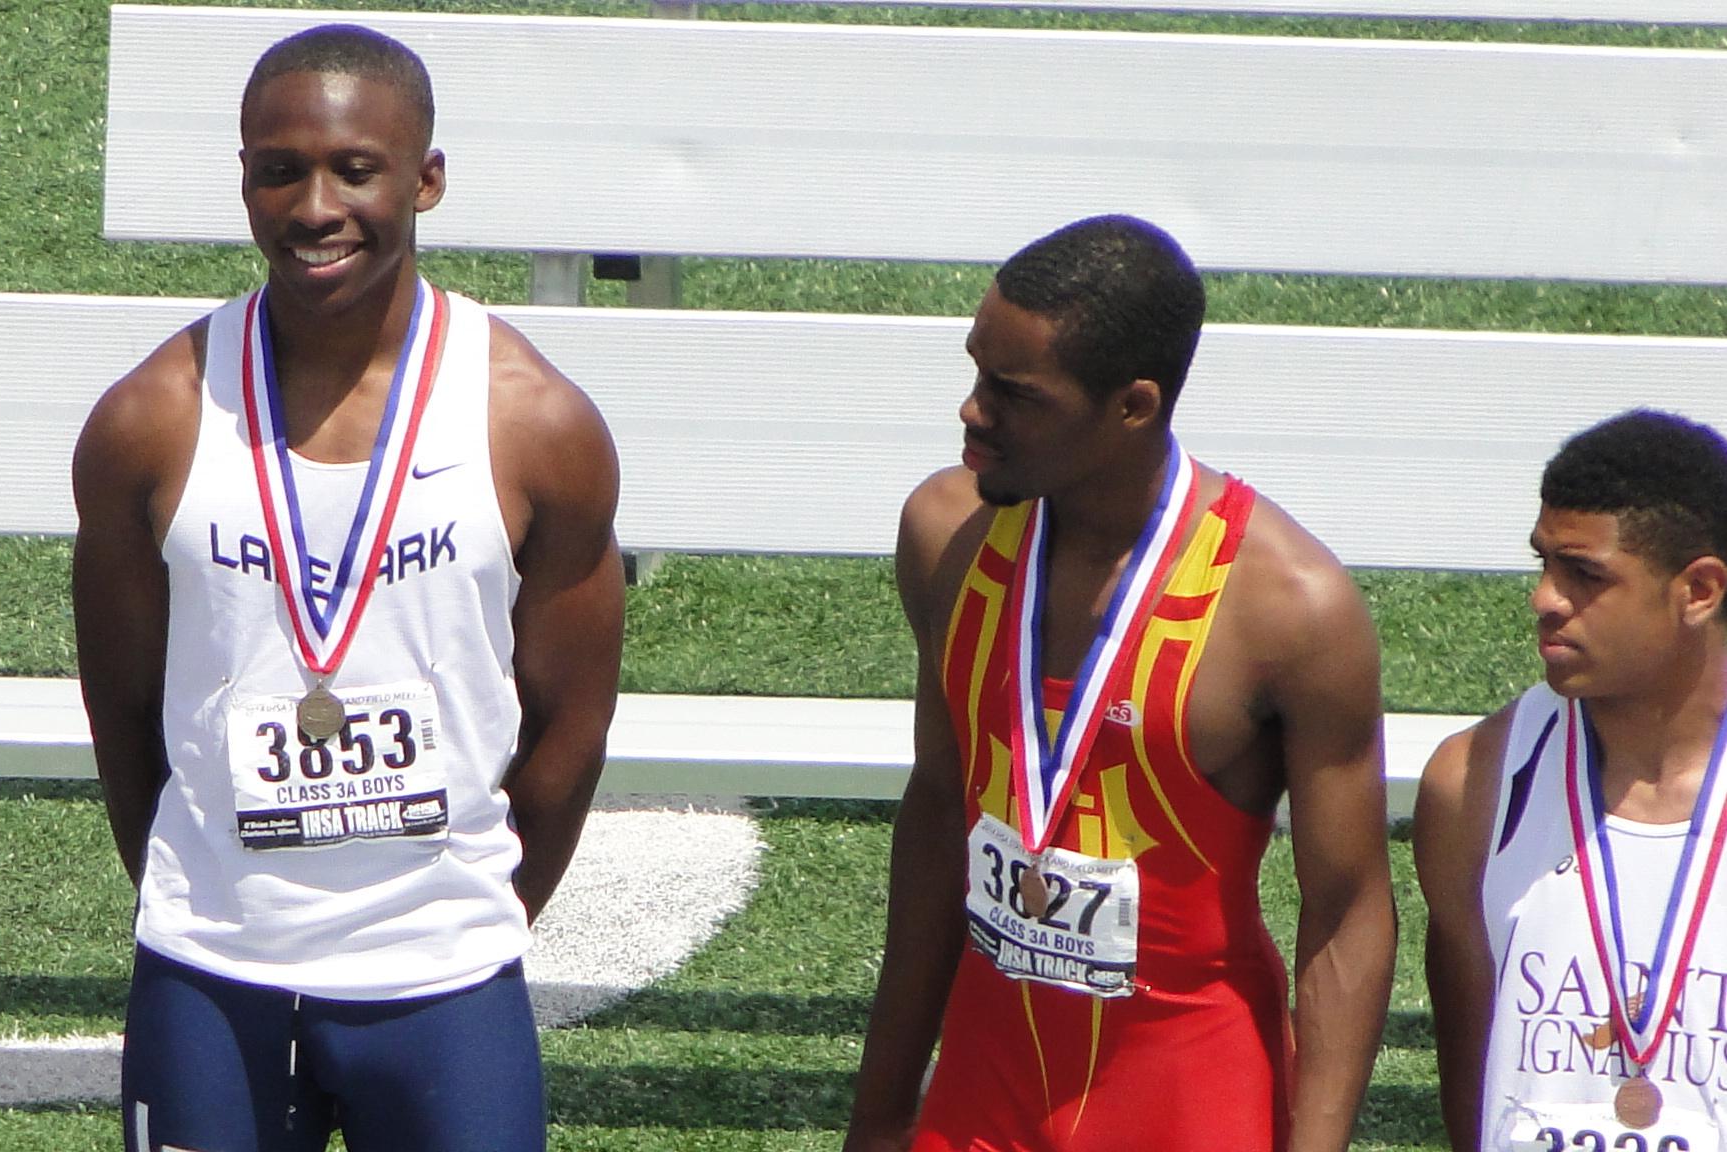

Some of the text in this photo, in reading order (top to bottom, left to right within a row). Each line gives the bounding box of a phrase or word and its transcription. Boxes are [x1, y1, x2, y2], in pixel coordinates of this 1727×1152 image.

[210, 520, 457, 601] LAE ARK
[256, 708, 416, 782] 3853
[277, 775, 405, 804] CLASS 3A BOYS
[301, 808, 344, 838] IHSA
[344, 801, 404, 834] TRACK
[982, 843, 1112, 936] 3827
[989, 906, 1026, 939] CLASS
[1029, 929, 1049, 947] 3A
[1053, 933, 1095, 956] BOYS
[998, 939, 1033, 972] IHSA
[1034, 954, 1088, 984] TRACK
[1516, 951, 1727, 1033] SANT
